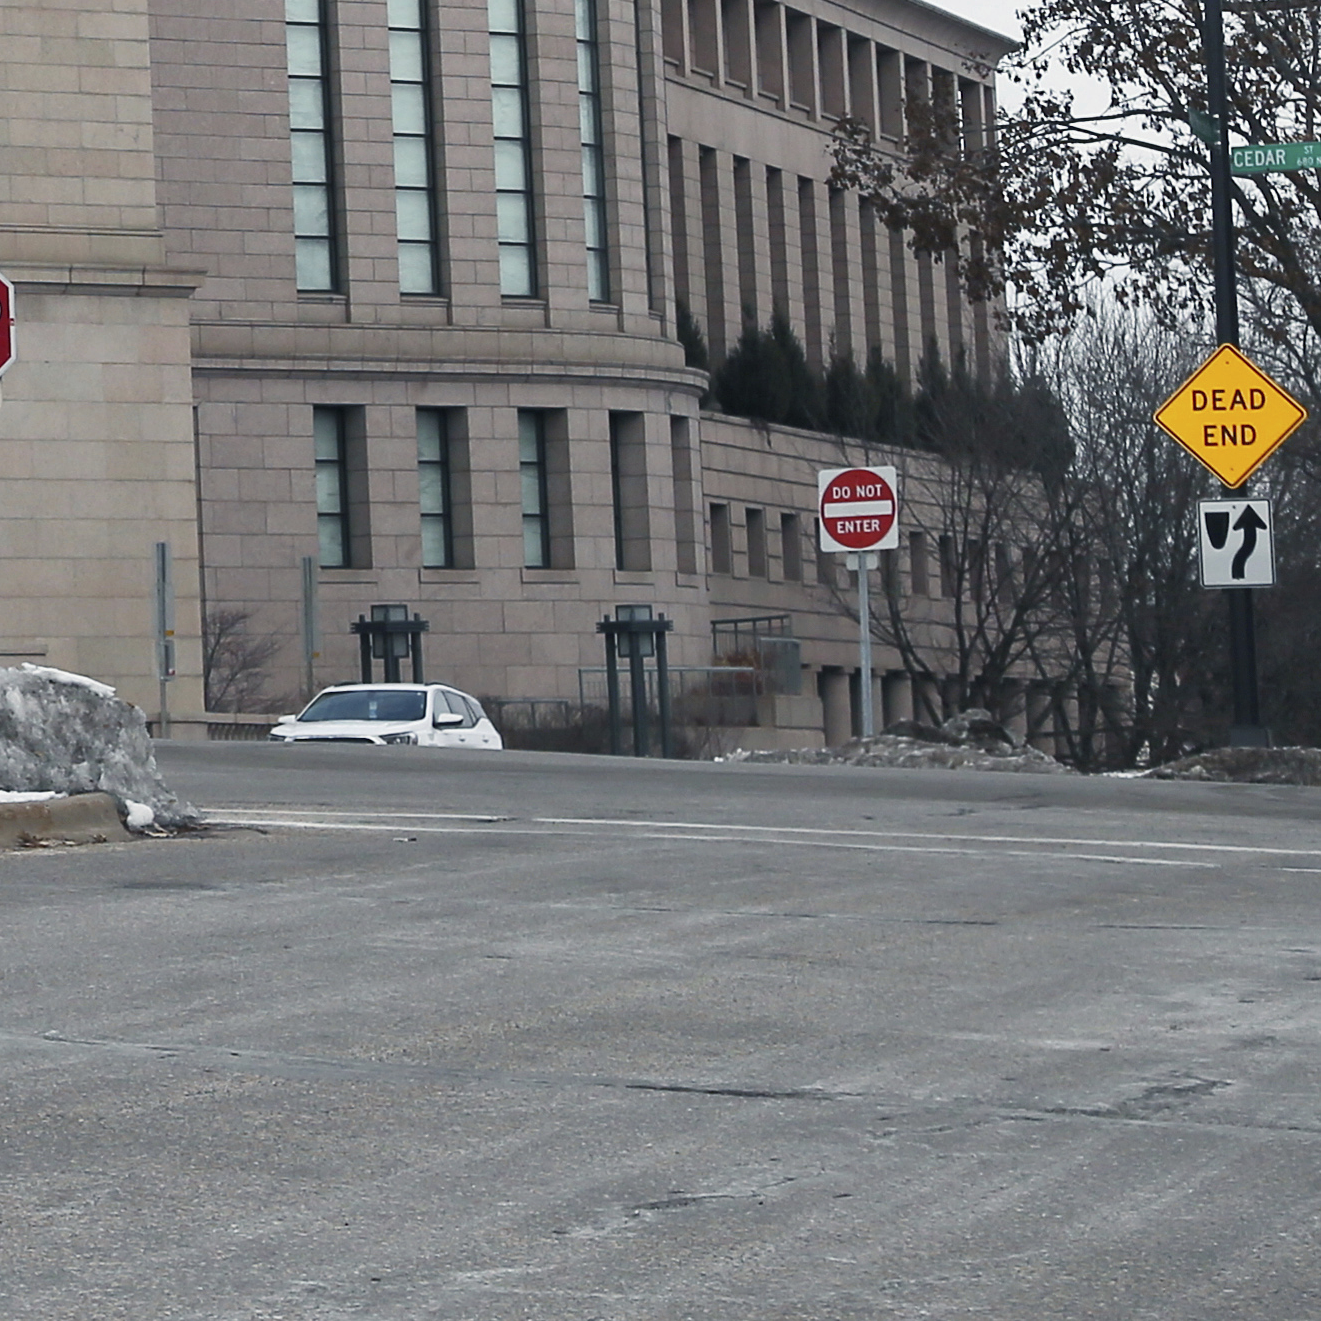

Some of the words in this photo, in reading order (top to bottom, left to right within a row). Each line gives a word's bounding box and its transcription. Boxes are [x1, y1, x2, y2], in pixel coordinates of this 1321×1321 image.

[1233, 149, 1286, 167] CEDAR
[1304, 145, 1314, 155] ST
[1192, 388, 1266, 412] DEAD
[1203, 424, 1257, 447] END
[832, 486, 851, 499] DO
[856, 484, 882, 498] NOT
[837, 519, 880, 534] ENTER
